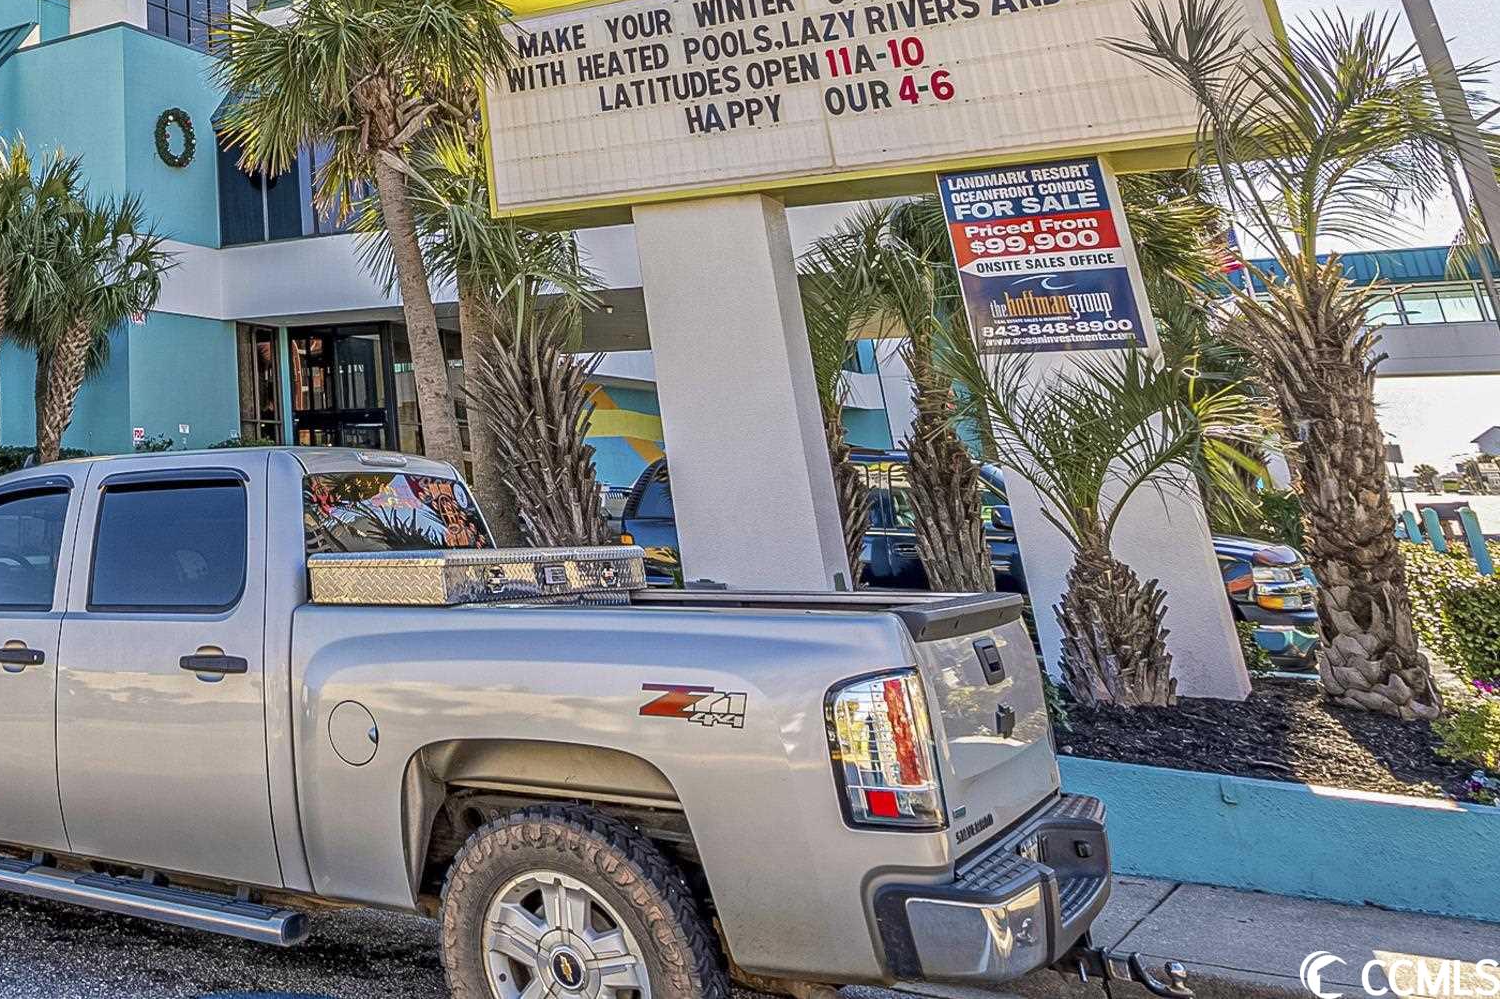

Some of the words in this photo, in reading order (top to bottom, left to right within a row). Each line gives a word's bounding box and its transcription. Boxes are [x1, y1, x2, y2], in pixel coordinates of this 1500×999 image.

[517, 24, 587, 59] MAKE
[605, 9, 672, 44] YOUR
[507, 60, 566, 93] WITH
[578, 43, 669, 81] HEATED
[599, 66, 740, 112] LATITUDES
[746, 51, 820, 90] OPEN
[825, 36, 925, 78] 11A-10
[685, 94, 781, 134] HAPPY
[824, 80, 892, 115] OUR
[899, 70, 955, 105] 4-6
[948, 170, 1029, 190] LANDMARK
[1031, 164, 1089, 182] RESORT
[951, 184, 1035, 204] OCEANFRONT
[1038, 178, 1096, 196] CONDOS
[954, 200, 1015, 220] FOR
[1021, 191, 1100, 214] SALE
[964, 220, 1035, 238] Priced
[1040, 217, 1098, 232] From
[970, 229, 1100, 256] $99,900
[976, 257, 1022, 274] ONSITE
[1026, 254, 1066, 270] SALES
[1069, 252, 1116, 267] OFFICE
[982, 319, 1133, 338] 843-848-8900
